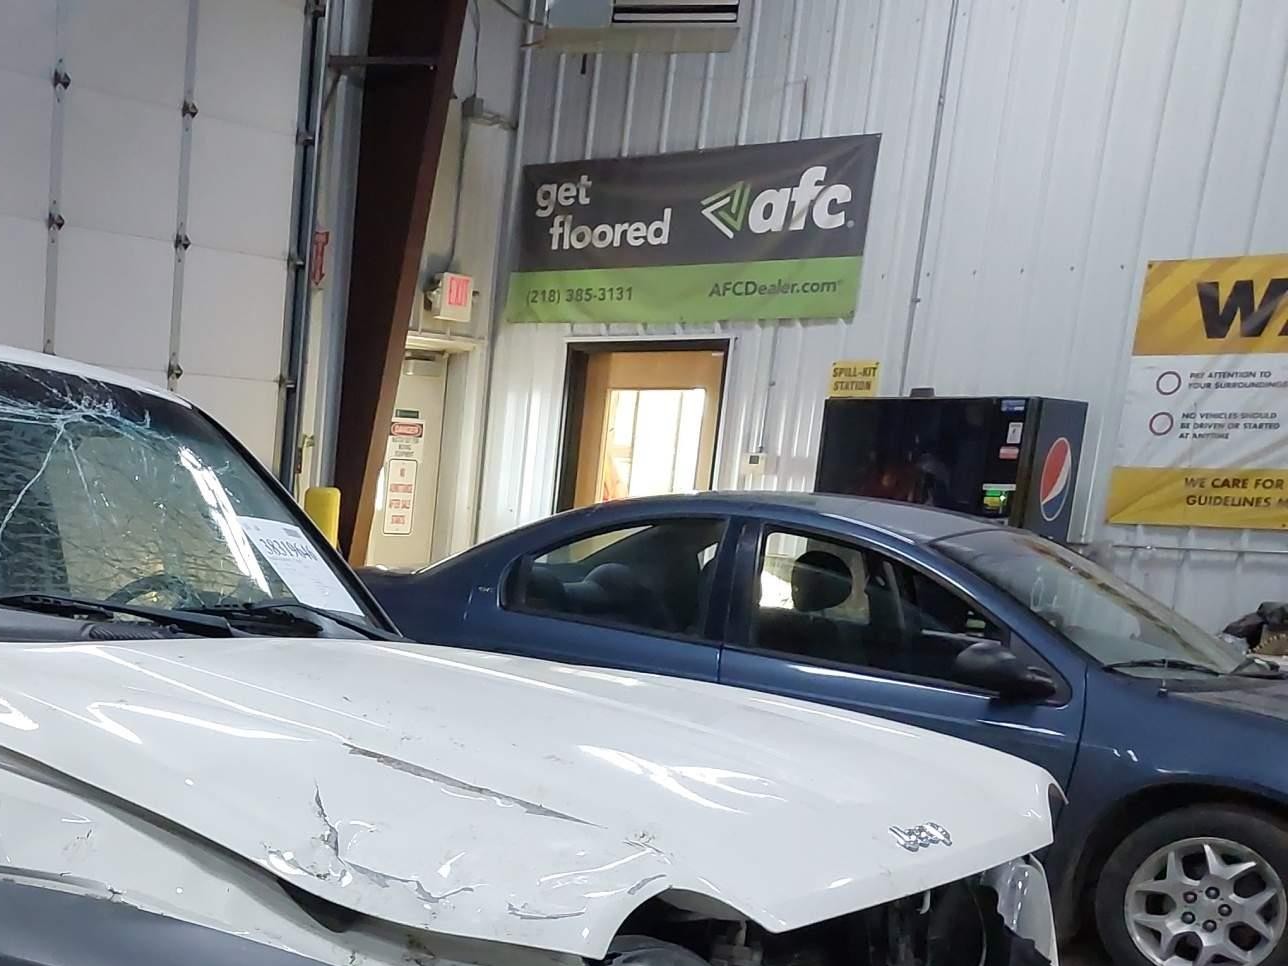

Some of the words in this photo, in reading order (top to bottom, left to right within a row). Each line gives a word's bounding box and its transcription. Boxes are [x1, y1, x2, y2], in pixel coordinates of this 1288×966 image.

[535, 174, 592, 218] get
[549, 207, 672, 250] floored
[708, 279, 838, 297] AFCDealer.com
[526, 287, 560, 307] (218)
[565, 286, 632, 302] 385-3131
[832, 366, 877, 378] SPILL-KIT
[833, 380, 872, 391] STATION
[1188, 382, 1212, 390] YOUR
[1185, 477, 1206, 489] WE
[1211, 477, 1249, 489] CARE
[1254, 478, 1284, 489] FOR
[1186, 495, 1272, 508] GUIDELINES
